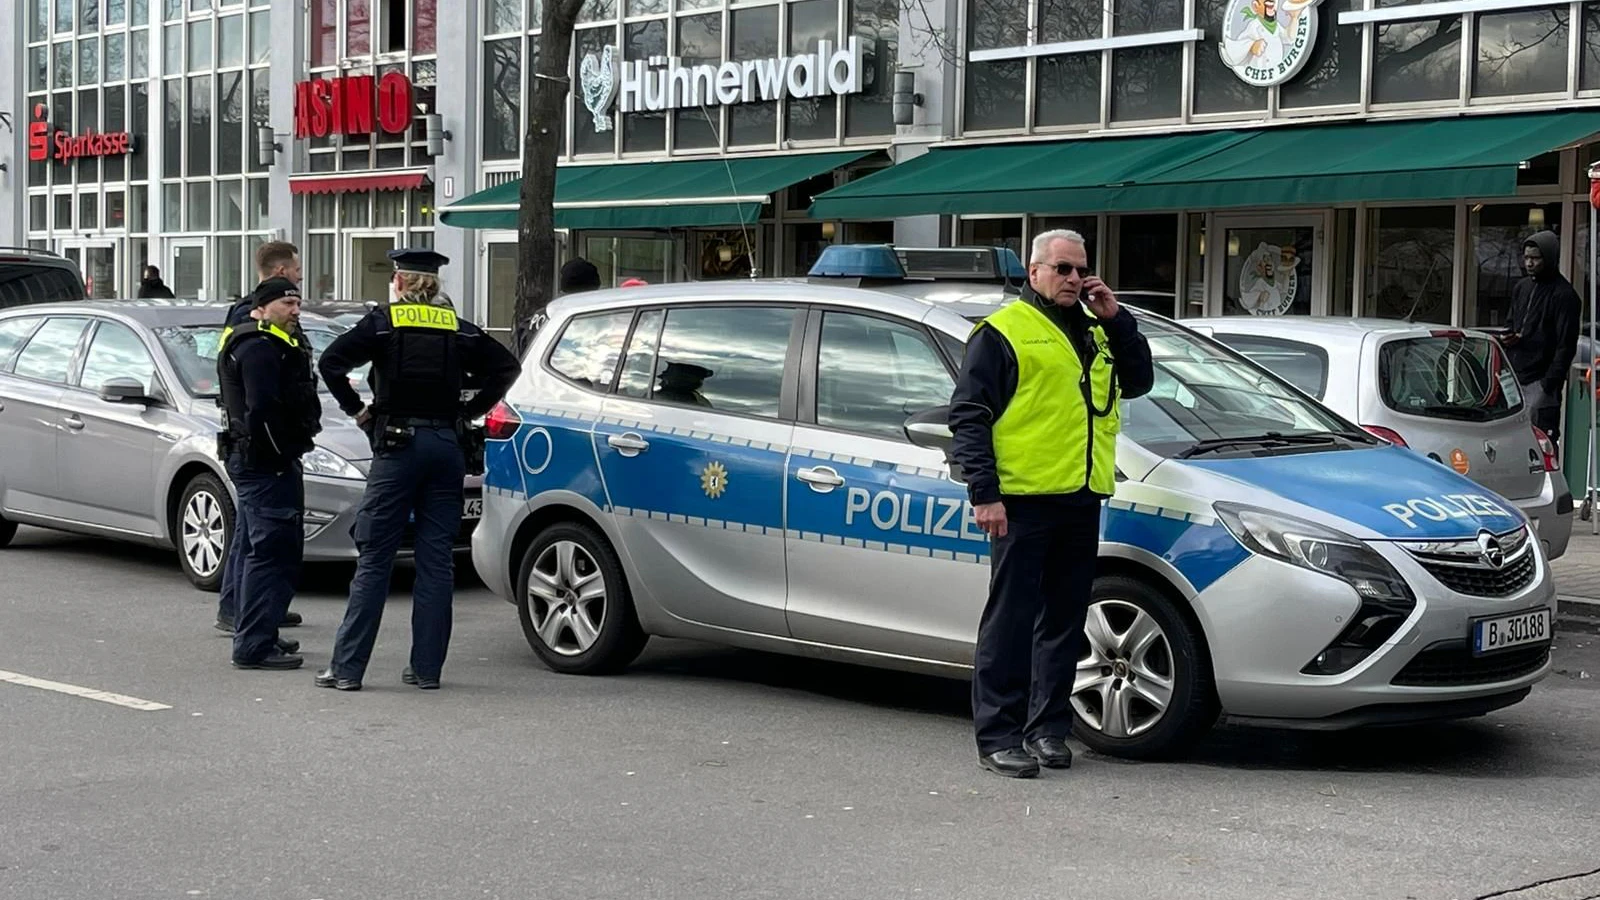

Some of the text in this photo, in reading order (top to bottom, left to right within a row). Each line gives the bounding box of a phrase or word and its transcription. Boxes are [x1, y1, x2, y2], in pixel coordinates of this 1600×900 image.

[1244, 16, 1308, 81] CHEF BURGER
[620, 36, 863, 113] Hühnerwald
[292, 70, 413, 140] ASINO
[54, 126, 129, 166] Sparkasse
[395, 307, 455, 326] POLIZEI
[845, 486, 992, 543] POLIZE
[1381, 494, 1513, 529] POLIZEI
[1488, 613, 1545, 646] B 30188
